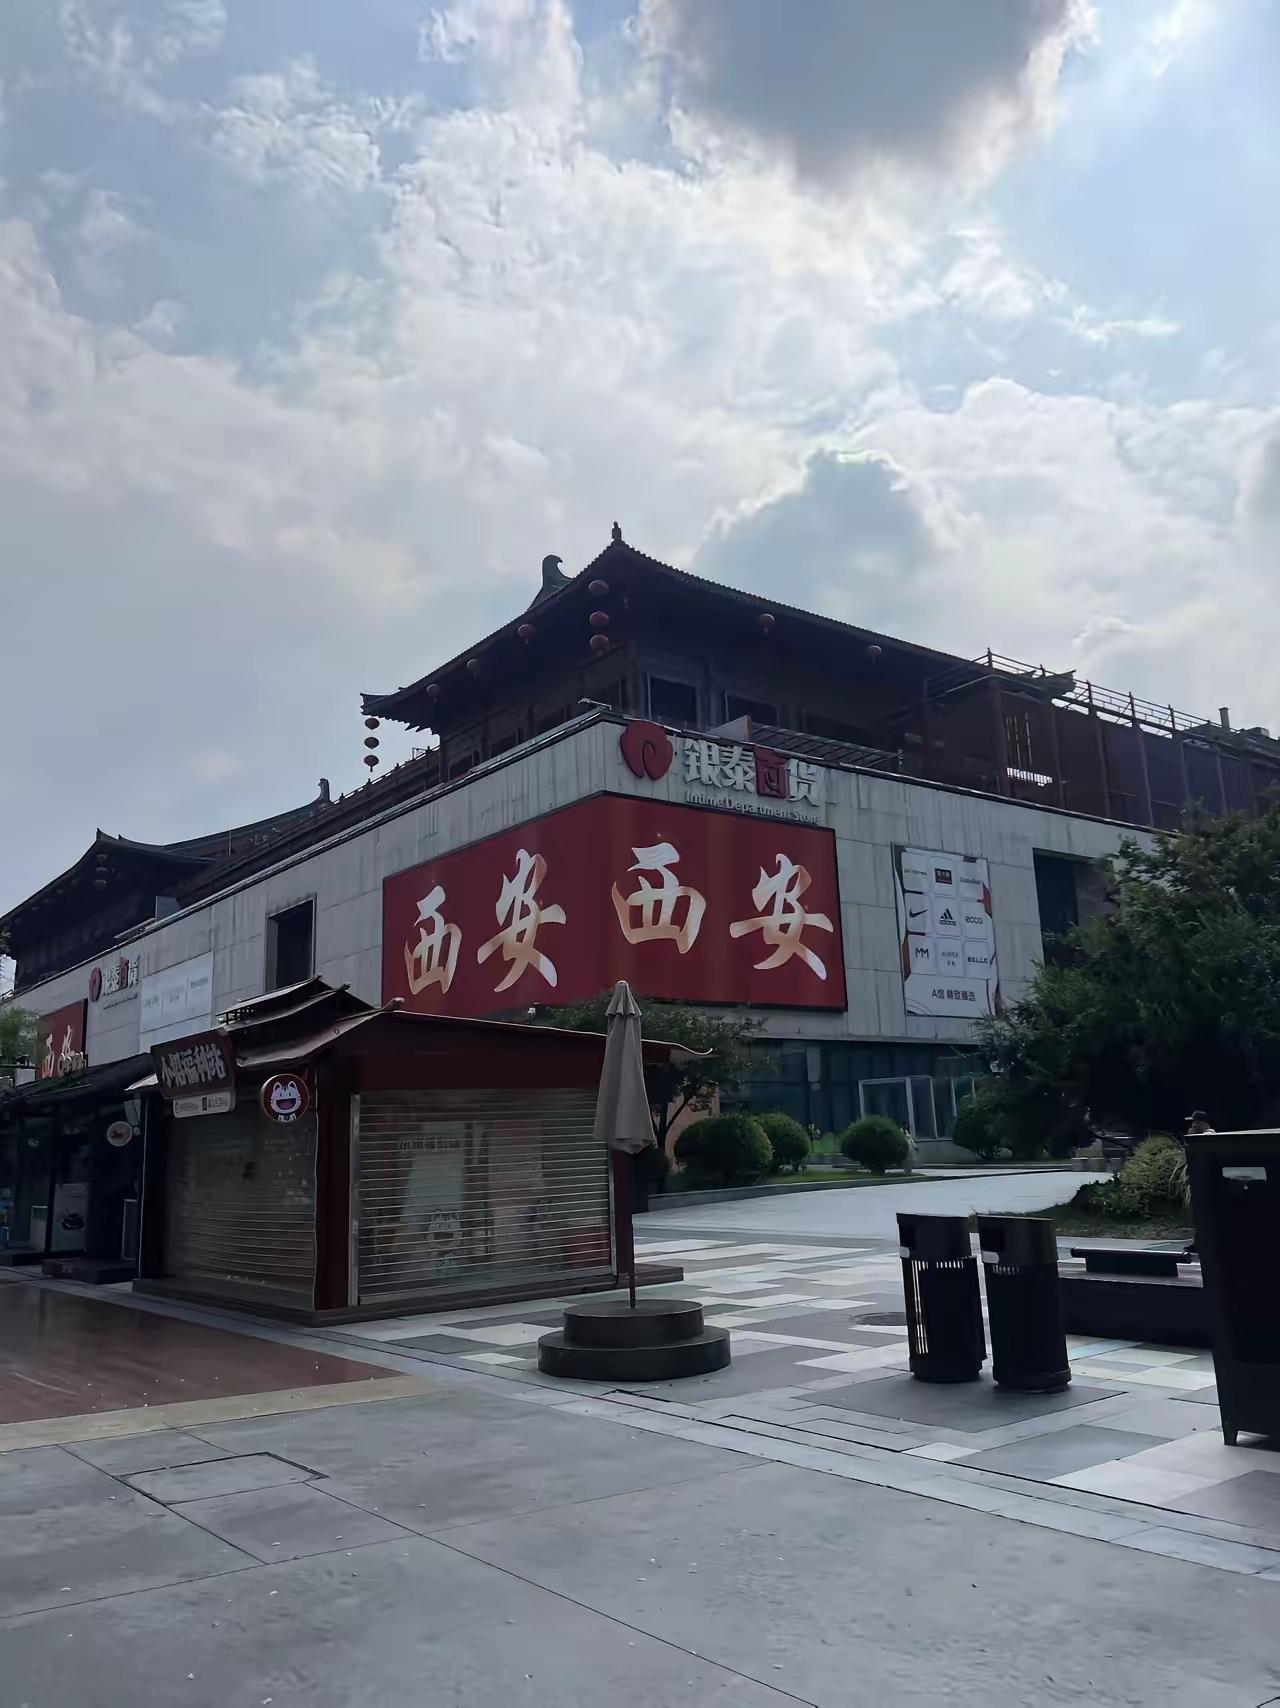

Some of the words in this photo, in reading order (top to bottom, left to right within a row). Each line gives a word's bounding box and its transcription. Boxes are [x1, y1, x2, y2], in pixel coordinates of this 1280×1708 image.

[683, 740, 819, 807] 银泰百货
[685, 791, 724, 808] Intime
[726, 796, 791, 819] Department
[792, 810, 819, 824] Store
[404, 849, 566, 994] 西安
[611, 842, 834, 980] 西安
[967, 956, 989, 964] BELLE
